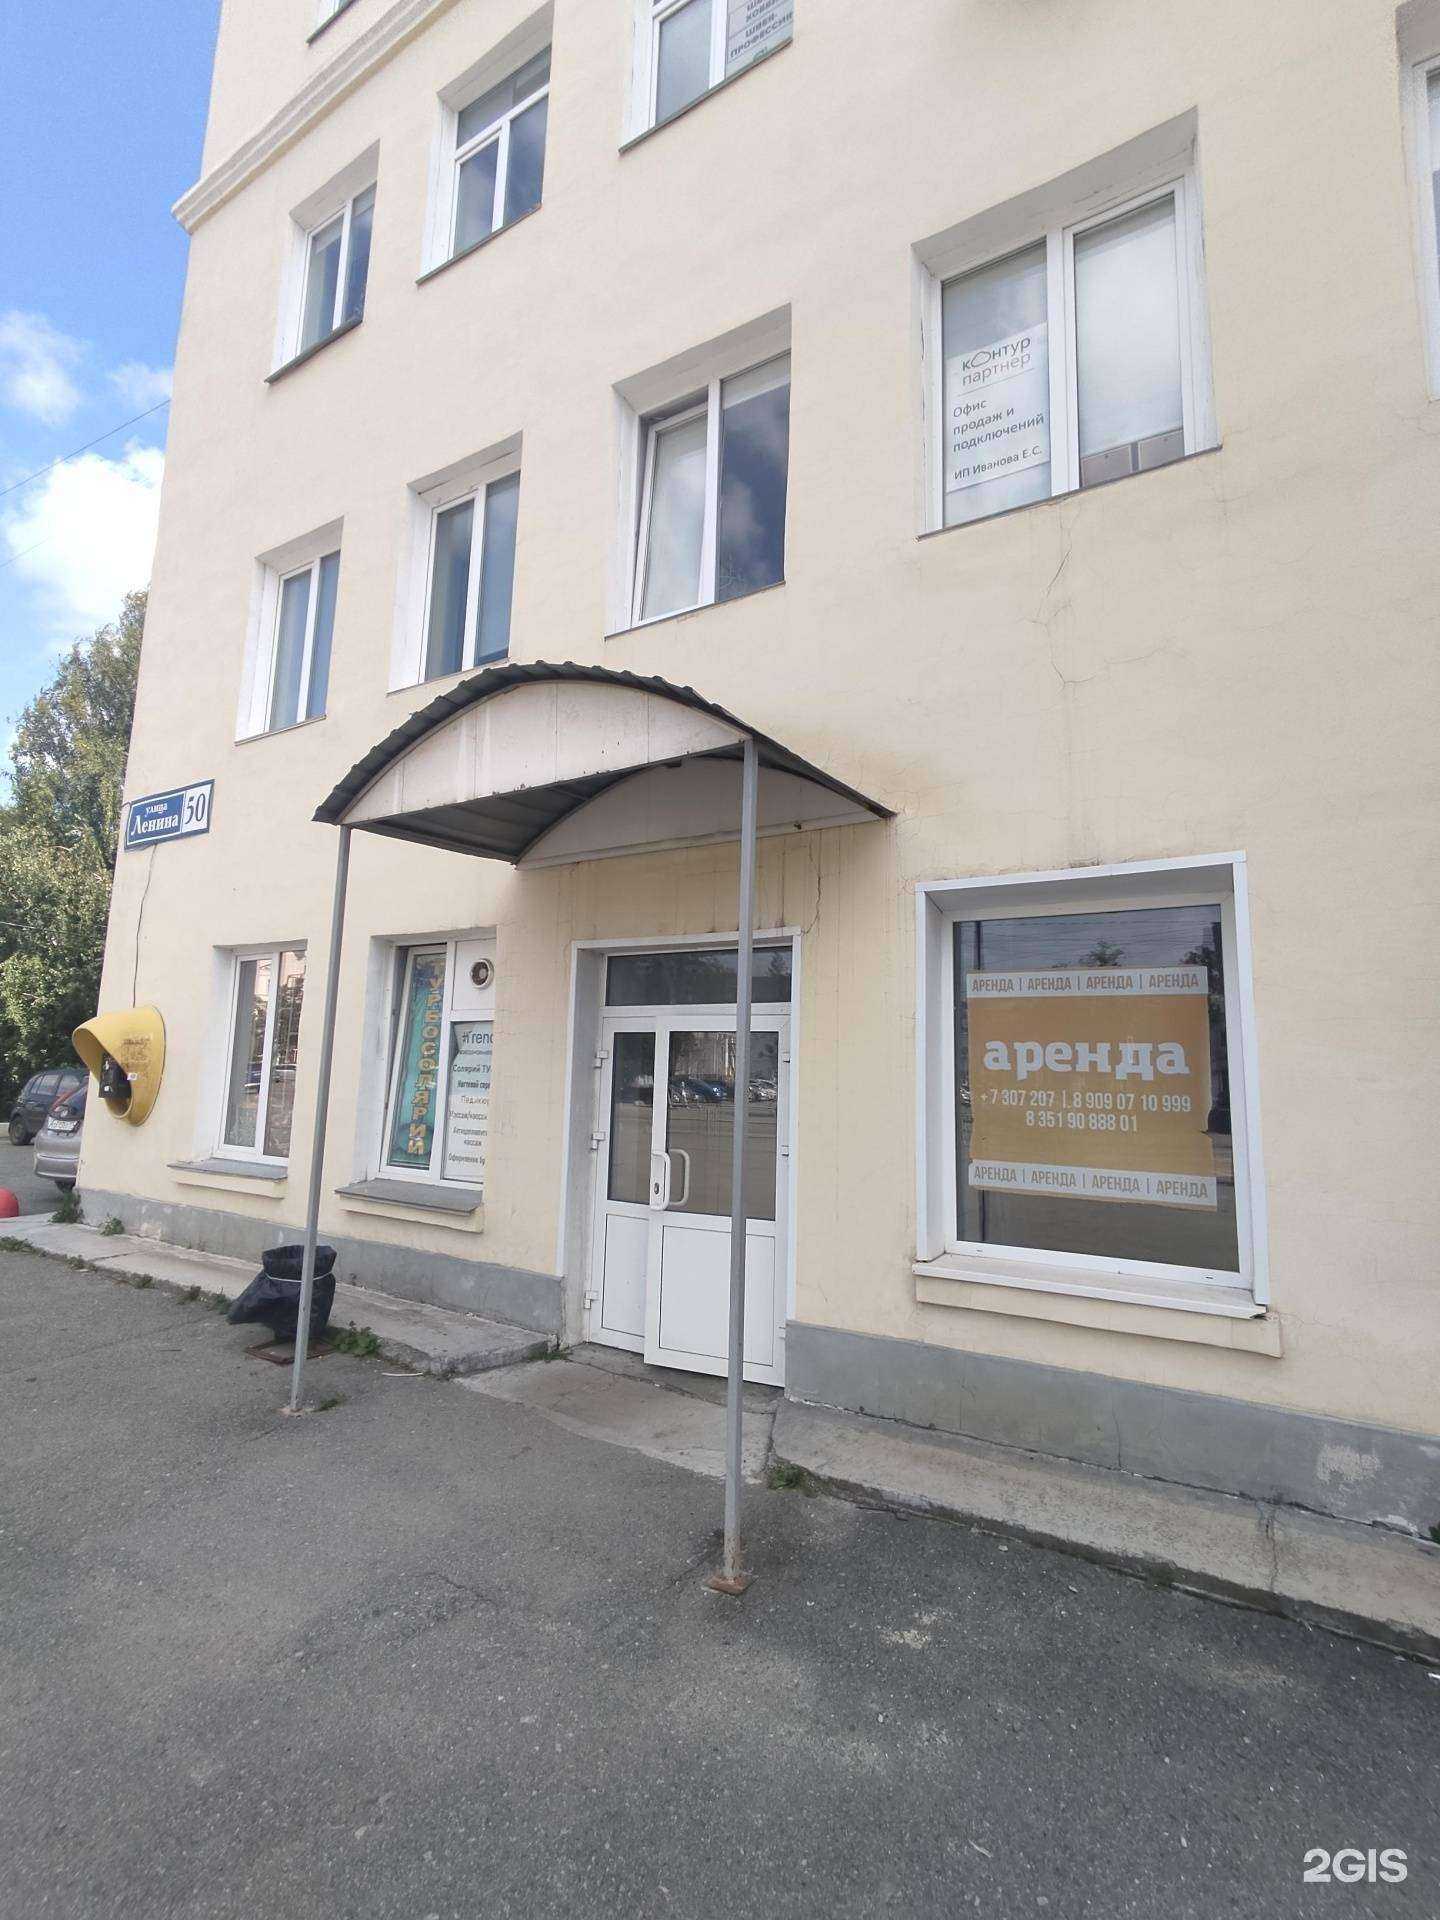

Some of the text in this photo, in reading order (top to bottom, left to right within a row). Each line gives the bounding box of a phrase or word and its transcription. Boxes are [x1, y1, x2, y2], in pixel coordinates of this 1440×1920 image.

[962, 353, 1031, 386] партнер
[953, 400, 987, 418] Офис
[953, 408, 1014, 436] продаж и
[953, 413, 1044, 452] подключений
[954, 446, 1042, 480] ИП Иванова Е.С.
[145, 793, 206, 824] улица 50
[130, 814, 179, 836] Ленина
[972, 973, 1199, 992] АРЕНДА АРЕНДА АРЕНДА АРЕНДА
[452, 1064, 492, 1074] Солярий ТУ
[983, 1040, 1191, 1080] аренда
[1002, 1089, 1026, 1106] 307
[1030, 1090, 1055, 1107] 207
[1072, 1091, 1082, 1108] 8
[1086, 1092, 1113, 1110] 909
[1117, 1093, 1135, 1110] 07
[1141, 1094, 1158, 1112] 10
[1162, 1095, 1192, 1112] 999
[1026, 1110, 1138, 1132] 8 351 90 888 01
[974, 1166, 1208, 1198] АРЕНДА АРЕНДА АРЕНДА АРЕНДА
